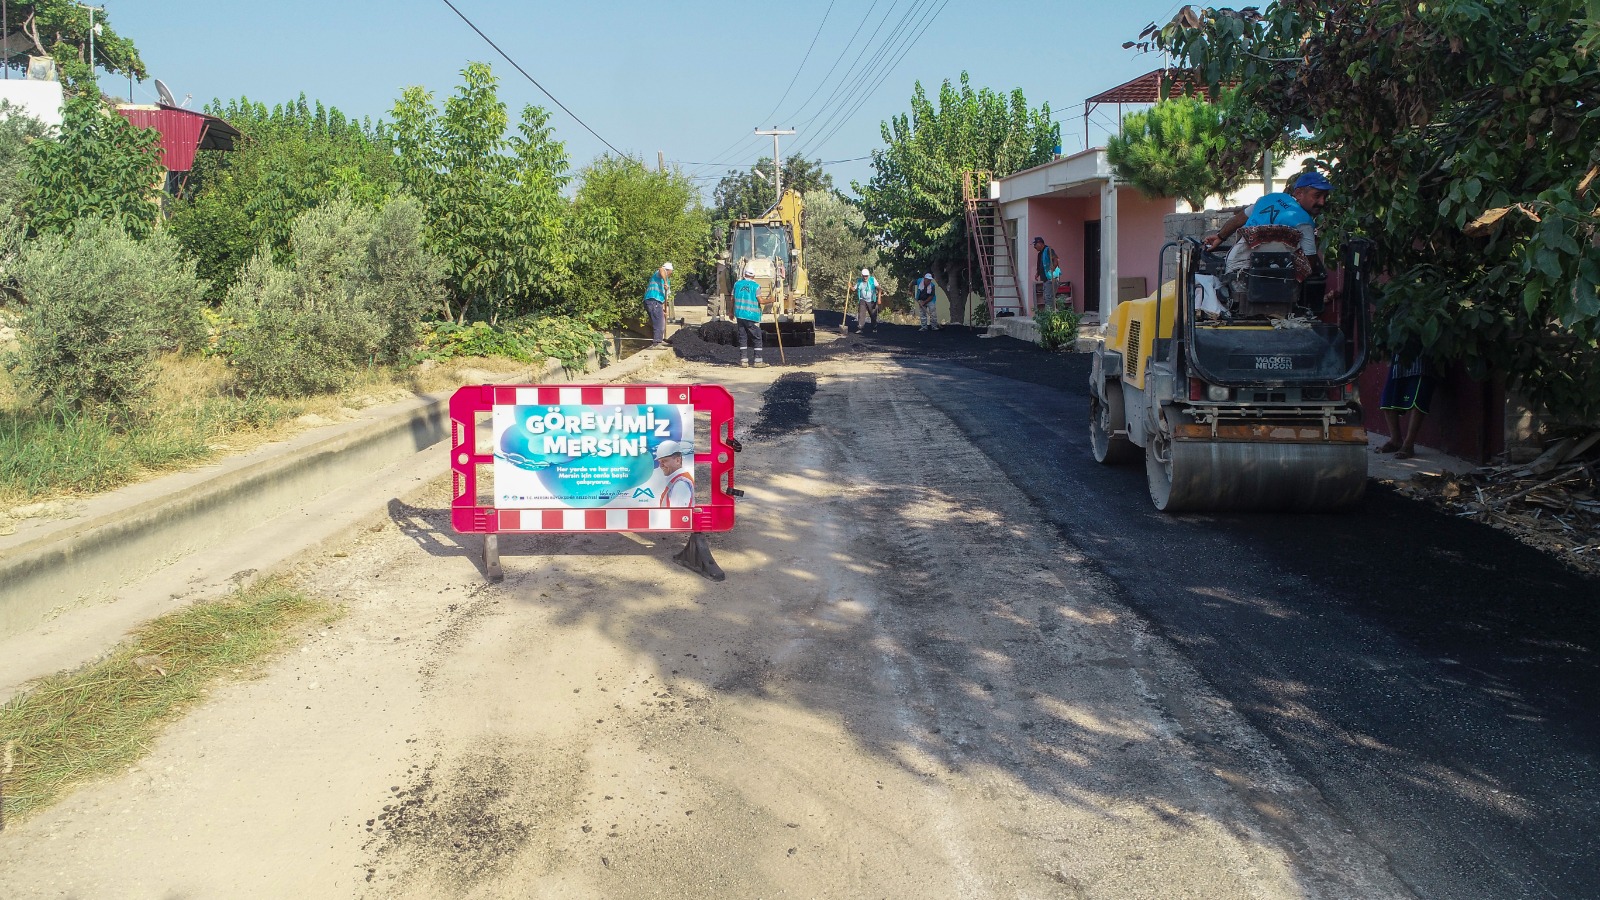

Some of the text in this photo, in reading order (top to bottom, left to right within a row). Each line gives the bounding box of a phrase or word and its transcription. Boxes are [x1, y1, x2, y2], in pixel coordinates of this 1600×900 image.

[1255, 356, 1292, 364] WACKER
[525, 406, 670, 437] GÖREVİMİZ
[543, 434, 648, 457] MERSİN!
